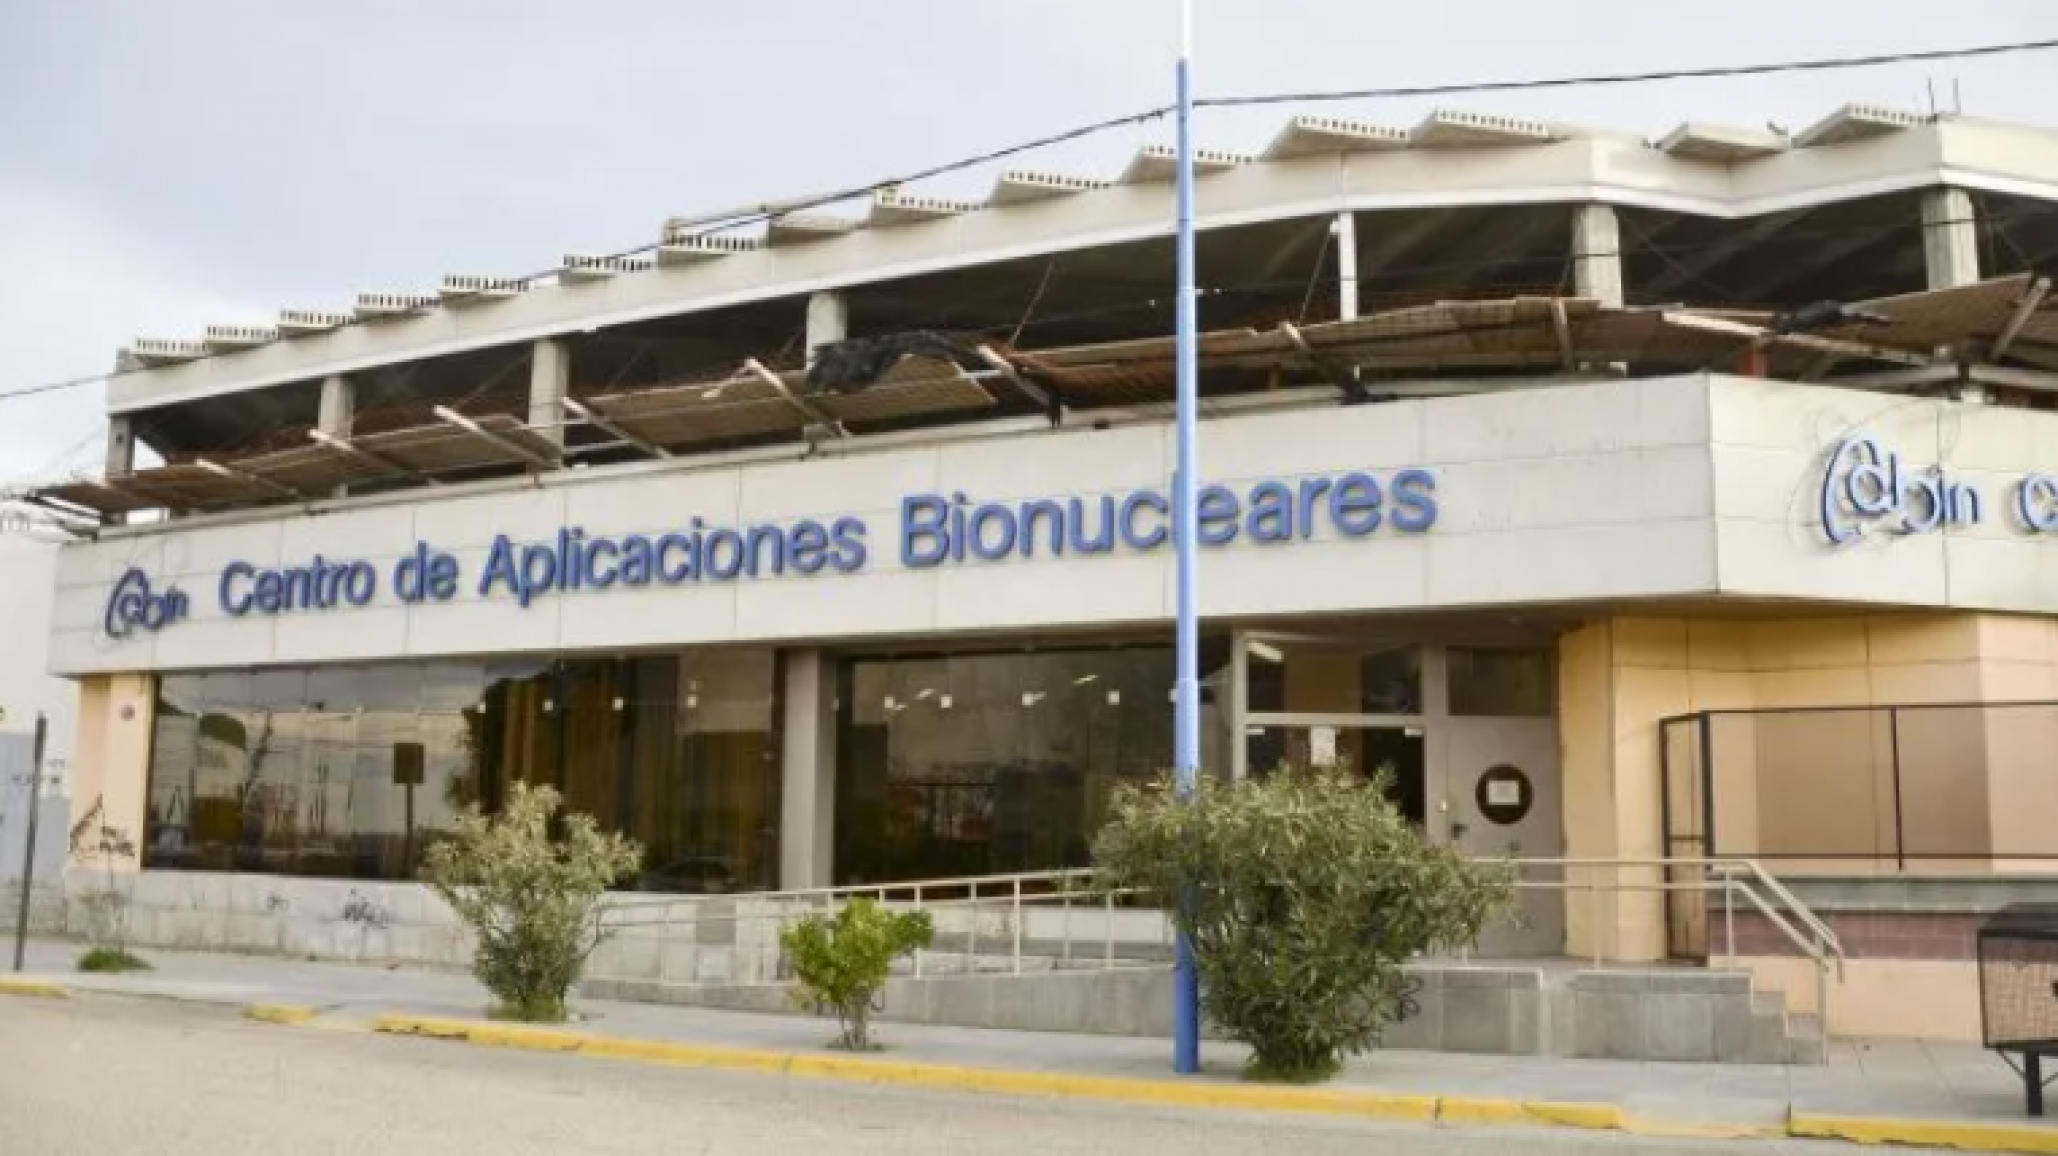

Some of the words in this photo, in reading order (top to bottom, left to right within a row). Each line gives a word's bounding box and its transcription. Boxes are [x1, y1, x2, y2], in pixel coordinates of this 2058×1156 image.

[219, 555, 376, 615] Centro
[393, 541, 459, 601] de
[479, 516, 867, 607] Aplicaciones
